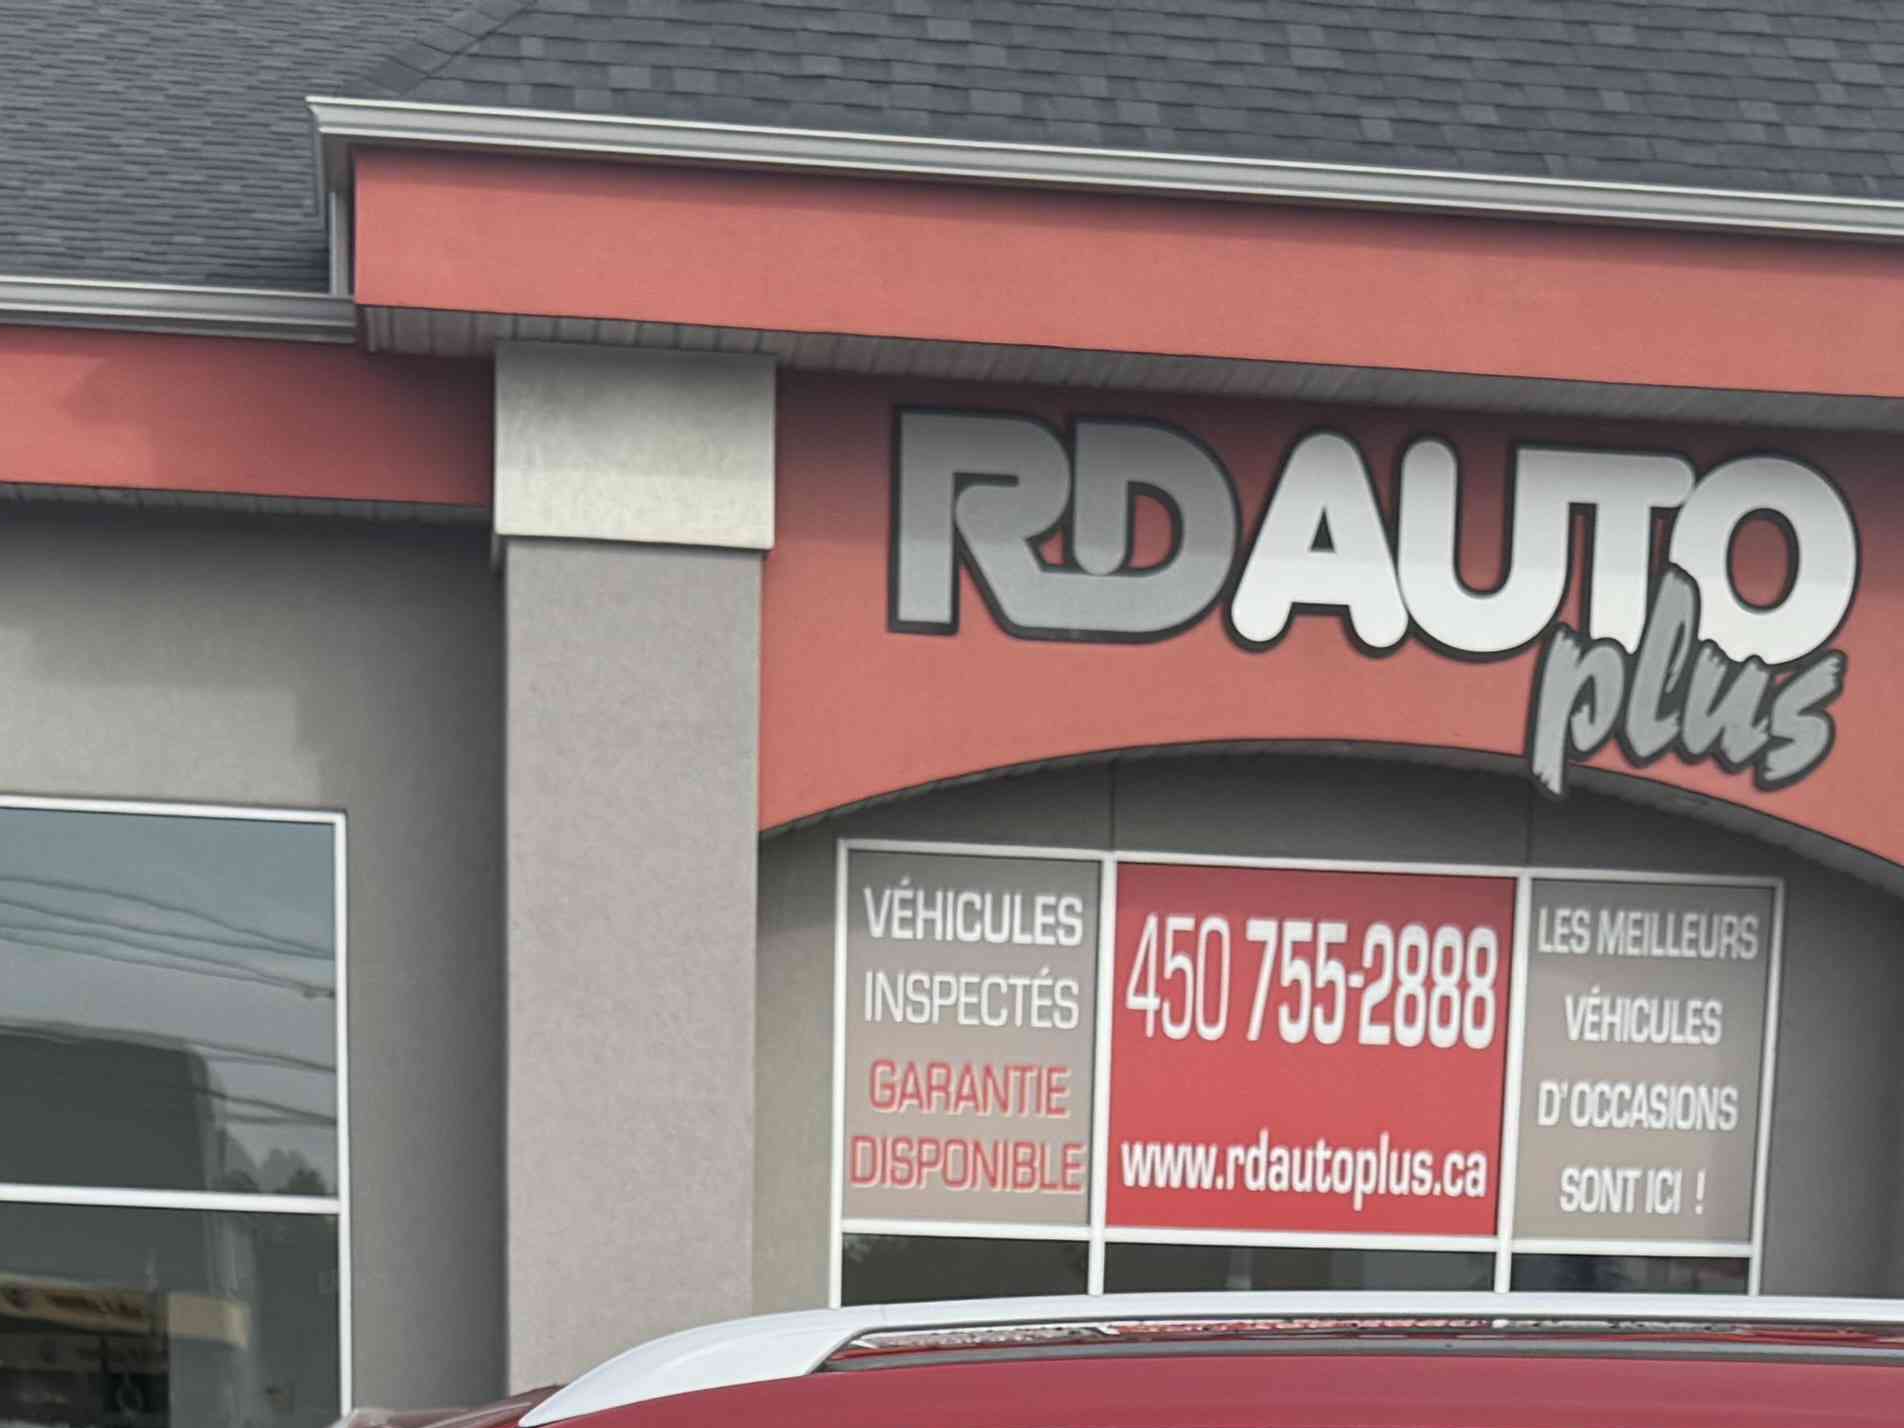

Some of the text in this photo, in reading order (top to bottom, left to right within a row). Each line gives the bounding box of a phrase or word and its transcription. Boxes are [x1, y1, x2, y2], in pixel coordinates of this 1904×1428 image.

[1529, 561, 1846, 795] plus
[863, 876, 1084, 946] VÉHICULES
[1537, 908, 1760, 960] LES MEILLEURS
[864, 965, 1080, 1030] INSPECTÉS
[1125, 912, 1498, 1050] 450 755-2888
[1565, 984, 1724, 1045] VÉHICULES
[869, 1057, 1072, 1119] GARANTIE
[849, 1133, 1087, 1195] DISPONIBLE
[1120, 1127, 1489, 1212] www.rdautoplus.ca
[1560, 1166, 1642, 1214] SONT
[1646, 1167, 1683, 1215] ICI
